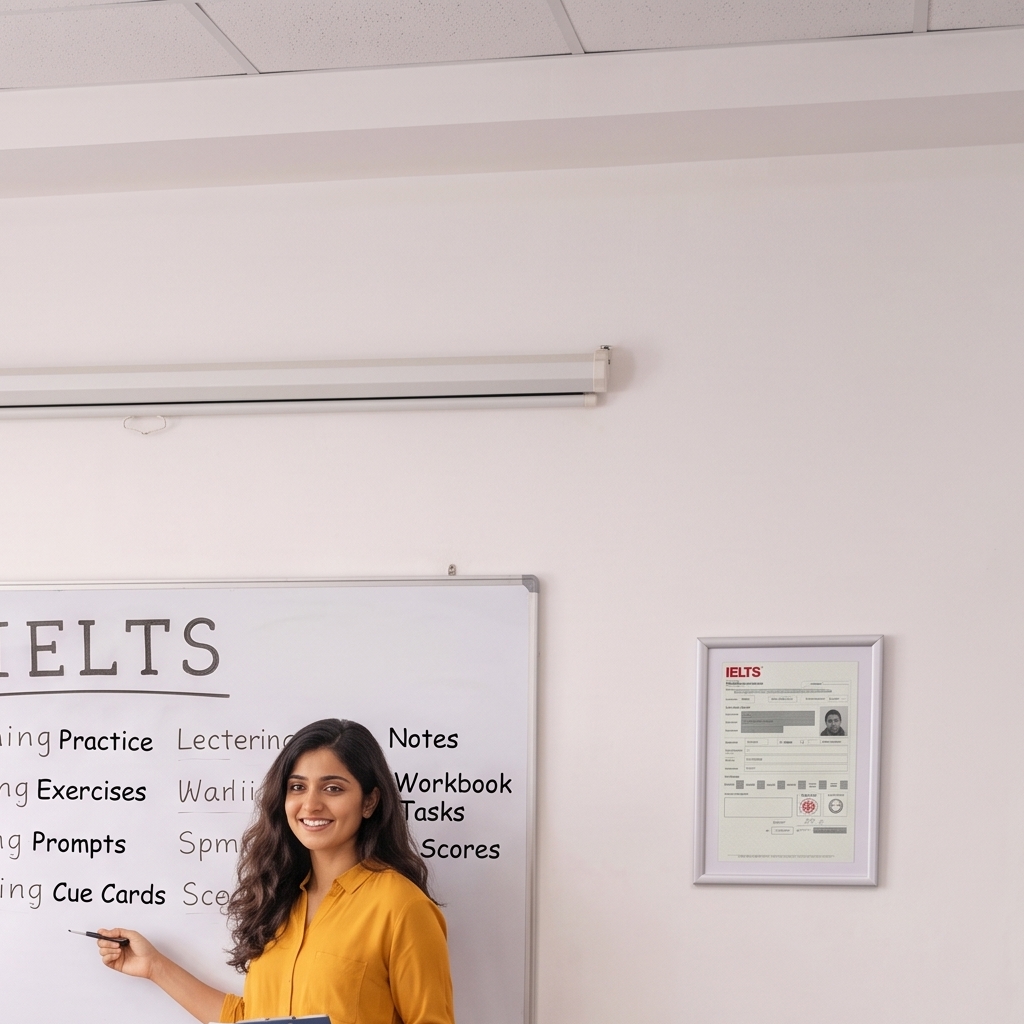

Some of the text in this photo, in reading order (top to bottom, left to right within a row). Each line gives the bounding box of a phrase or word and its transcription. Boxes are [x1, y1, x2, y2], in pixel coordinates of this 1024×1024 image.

[726, 667, 761, 678] IELTS
[60, 729, 153, 751] Practice
[390, 727, 458, 748] Notes
[37, 778, 146, 802] Exercises
[394, 772, 513, 794] Workbook
[400, 800, 465, 822] Tasks
[33, 831, 126, 859] Prompts
[420, 838, 500, 859] Scores
[53, 882, 93, 903] Cue
[101, 883, 166, 905] Cards
